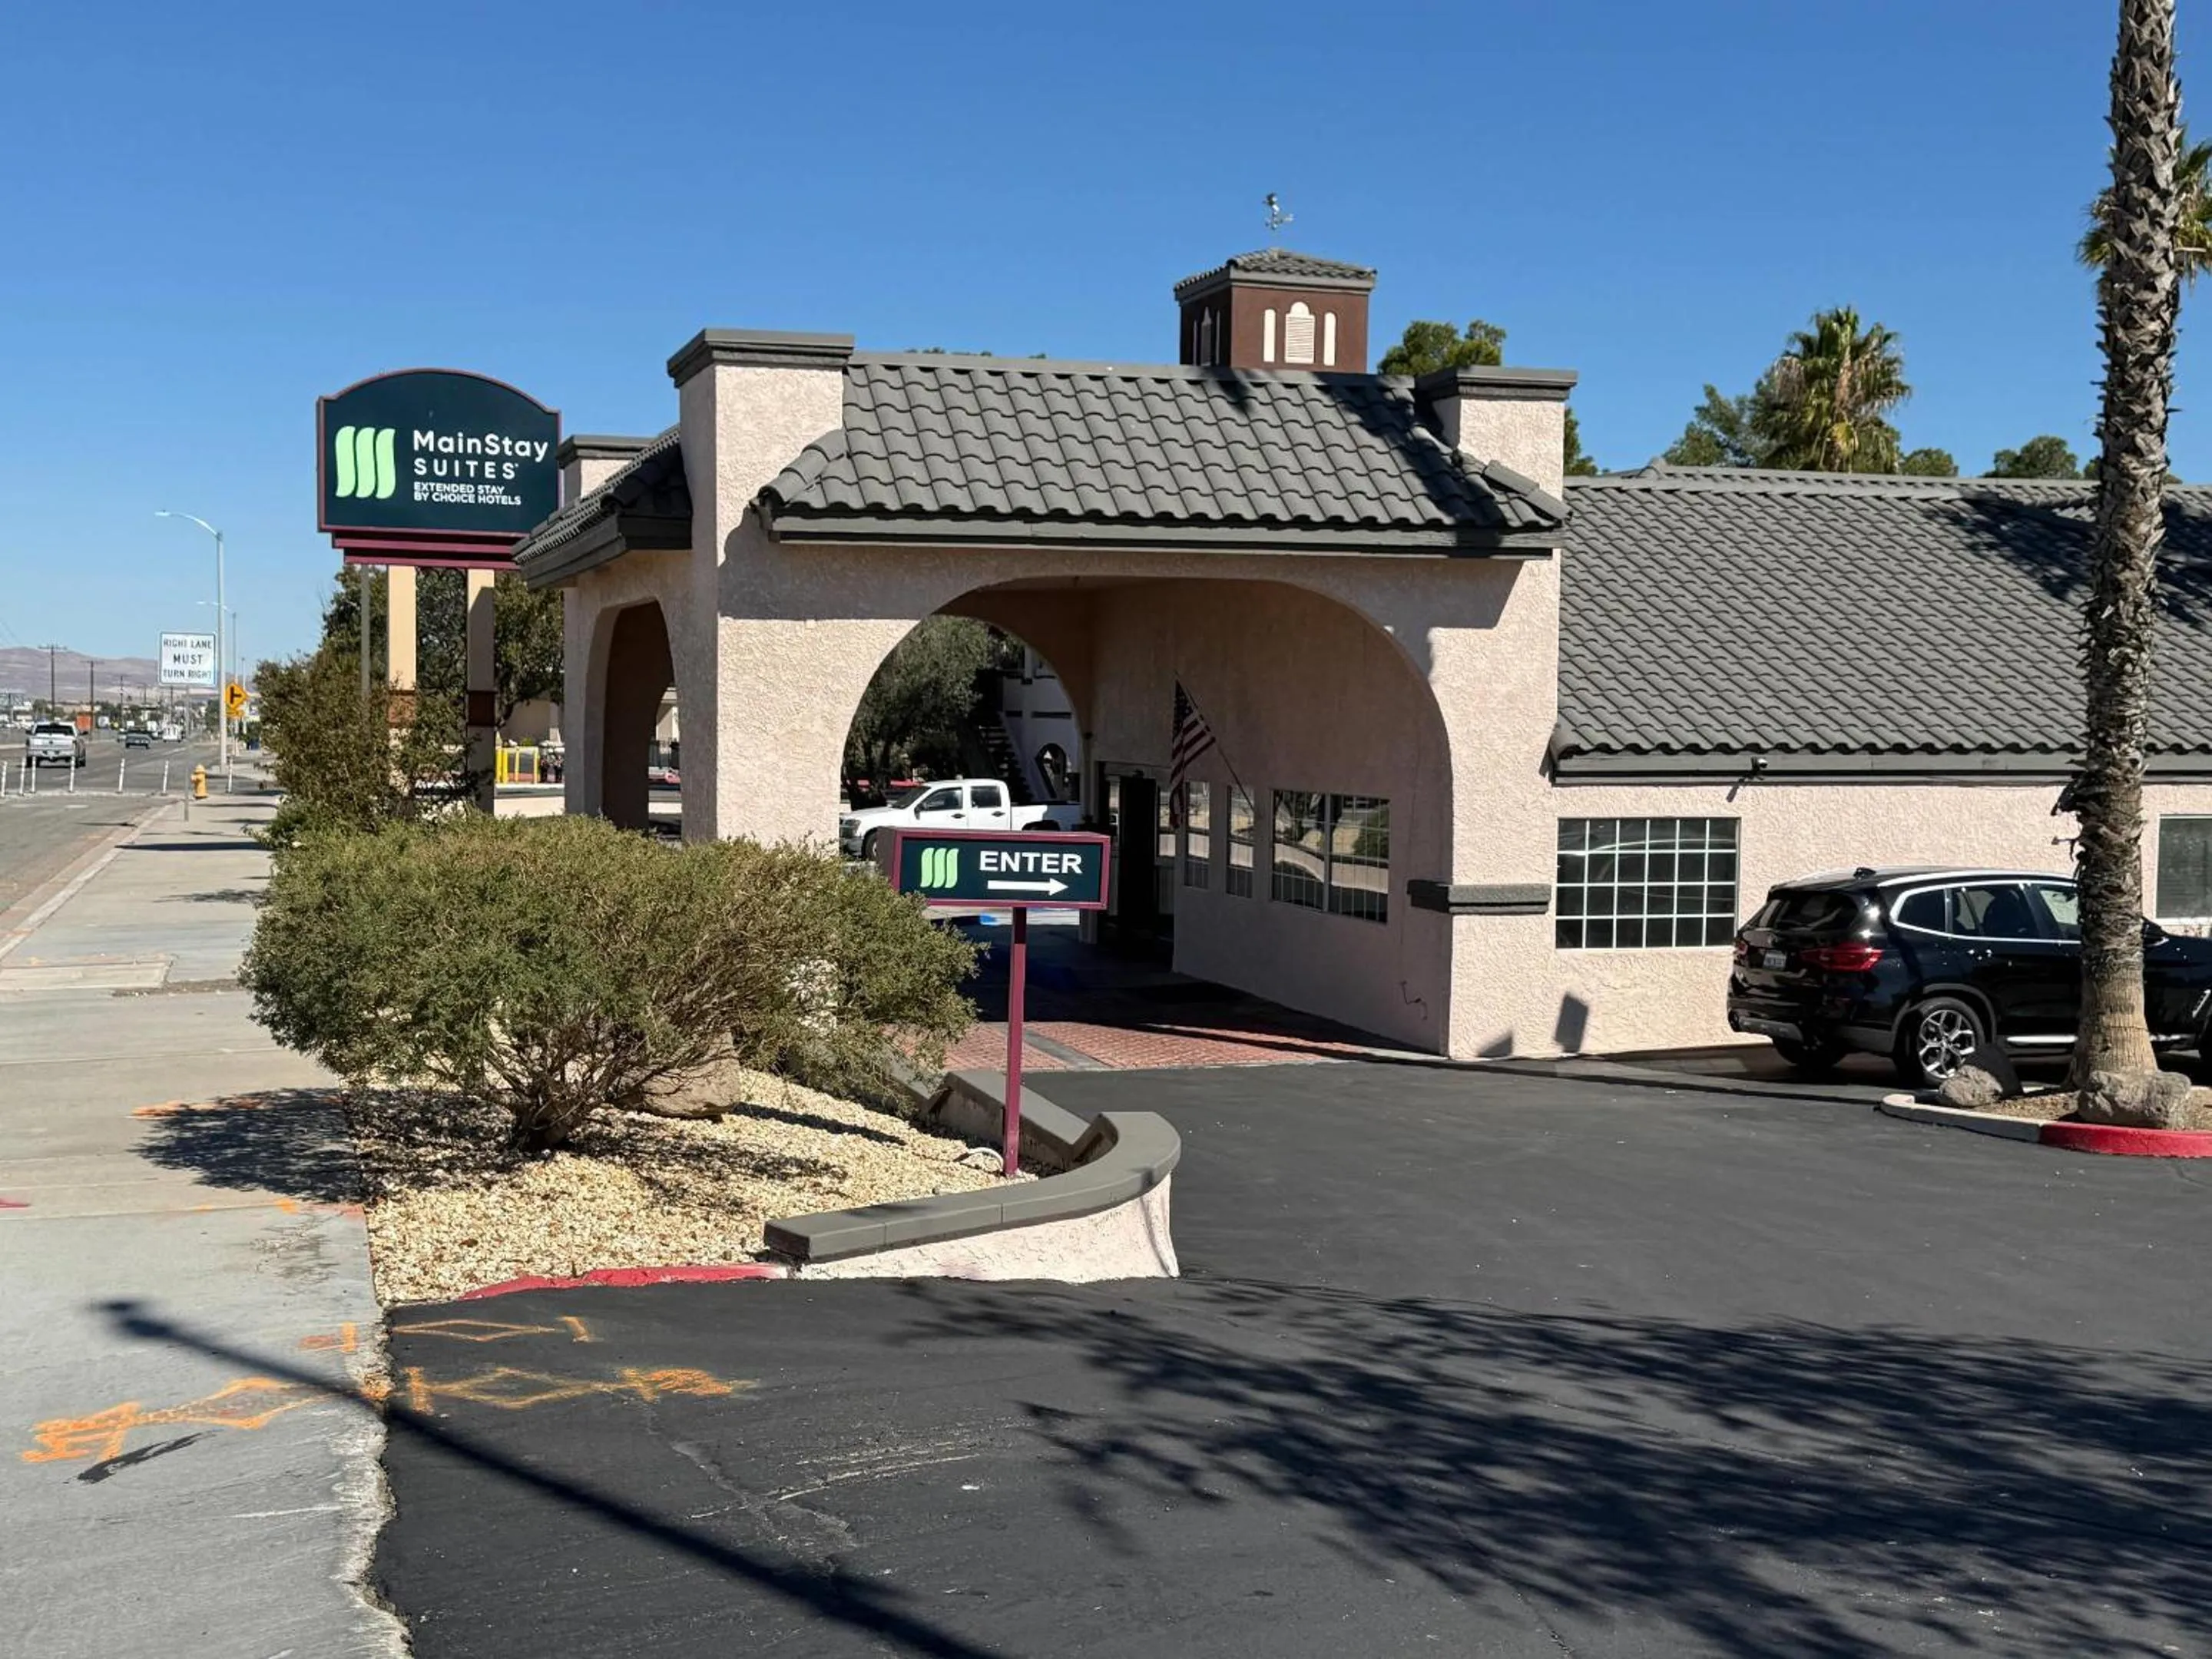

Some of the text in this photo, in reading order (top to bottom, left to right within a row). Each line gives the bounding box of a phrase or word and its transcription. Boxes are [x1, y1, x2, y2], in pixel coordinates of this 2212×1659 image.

[413, 429, 548, 462] MainStay
[414, 458, 516, 479] SUITES
[413, 482, 505, 495] EXTENDED STAY
[413, 492, 522, 505] BY CHOICE HOTELS
[190, 639, 212, 650] LANE
[173, 652, 202, 665] MUST
[163, 669, 185, 678] TURN
[979, 850, 1083, 874] ENTER
